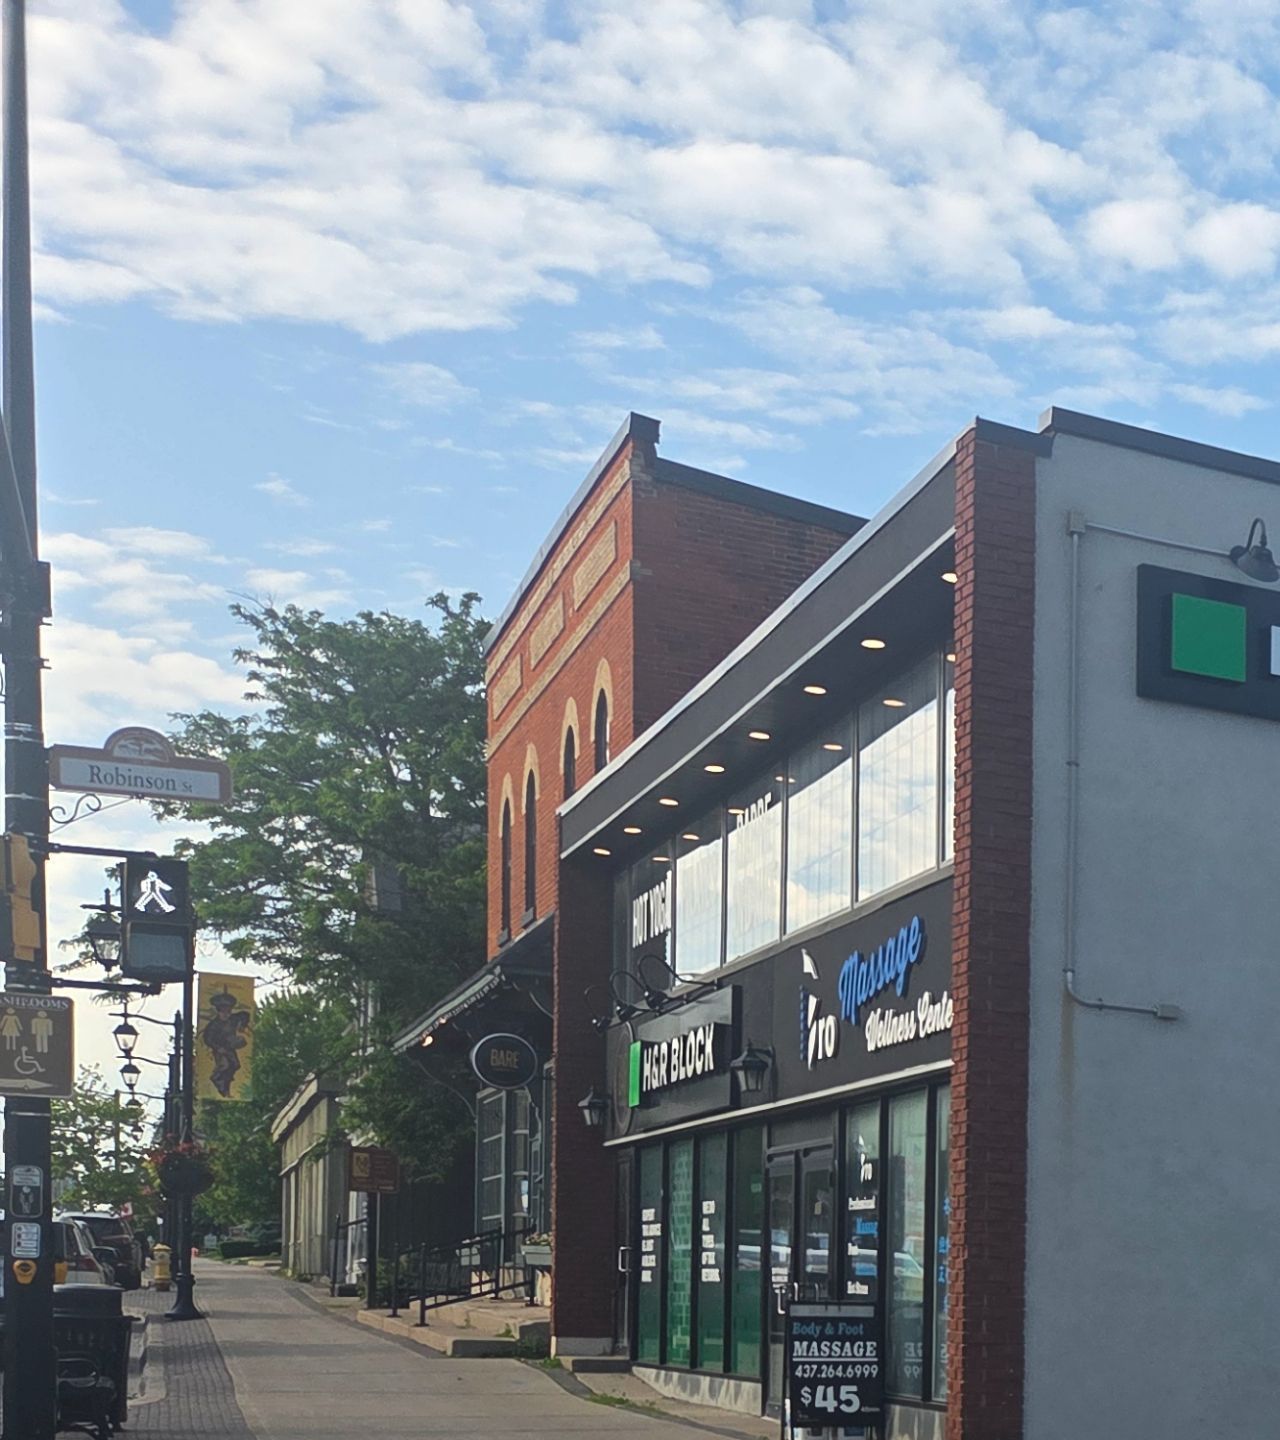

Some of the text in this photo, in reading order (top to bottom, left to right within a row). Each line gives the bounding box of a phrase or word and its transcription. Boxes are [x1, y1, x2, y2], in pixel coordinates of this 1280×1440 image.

[88, 764, 177, 792] Robinson
[838, 915, 922, 1026] Massage
[865, 990, 954, 1053] Wellness Cente
[642, 1022, 715, 1093] H&R BLOCK
[792, 1322, 864, 1338] Body & Foot
[792, 1340, 877, 1357] MASSAGE
[794, 1364, 879, 1379] 437.264.6999
[800, 1384, 861, 1414] $45
